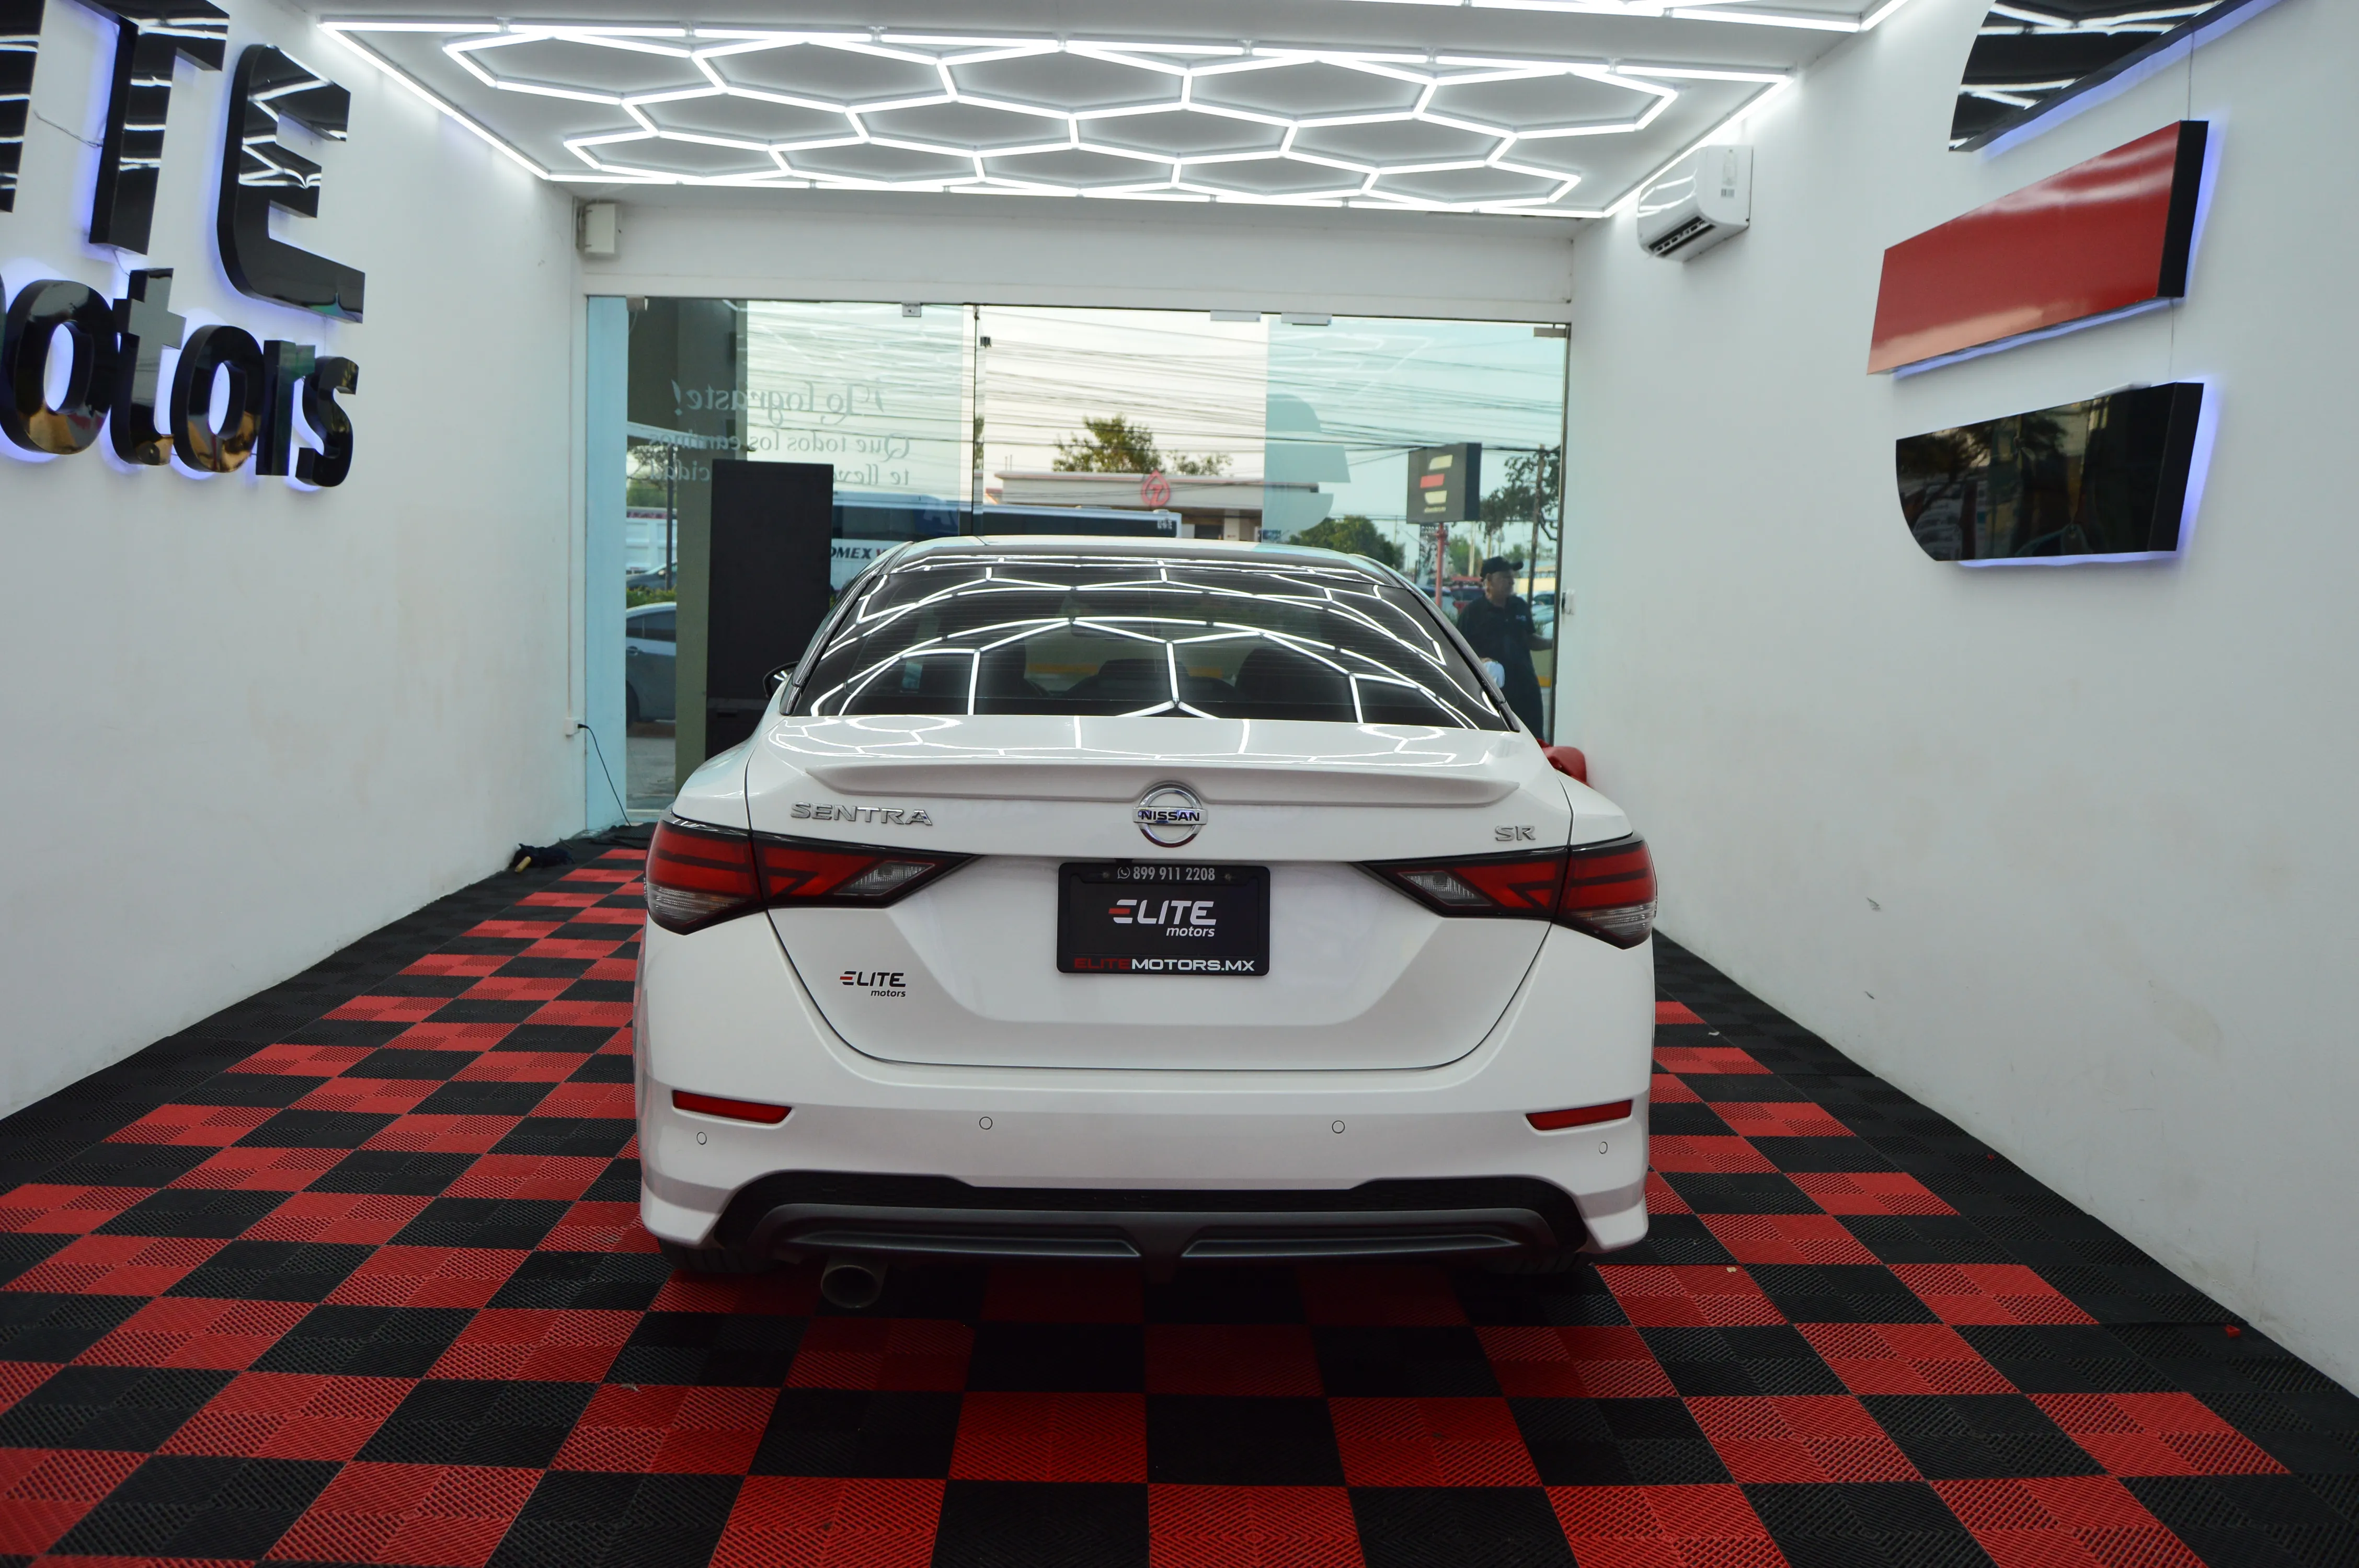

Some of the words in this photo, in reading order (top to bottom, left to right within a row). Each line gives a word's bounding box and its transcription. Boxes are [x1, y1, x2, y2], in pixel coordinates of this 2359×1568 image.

[0, 268, 359, 487] otors
[791, 802, 933, 826] SENTRA
[1141, 810, 1199, 822] NISSAN
[1495, 825, 1536, 841] SR
[1133, 866, 1155, 880] 899
[1159, 867, 1180, 880] 911
[1186, 867, 1215, 881] 2208
[1108, 899, 1217, 925] ELITE
[1166, 926, 1215, 937] motors
[1074, 958, 1255, 971] ELITEMOTORS.MX
[840, 971, 906, 987] ELITE
